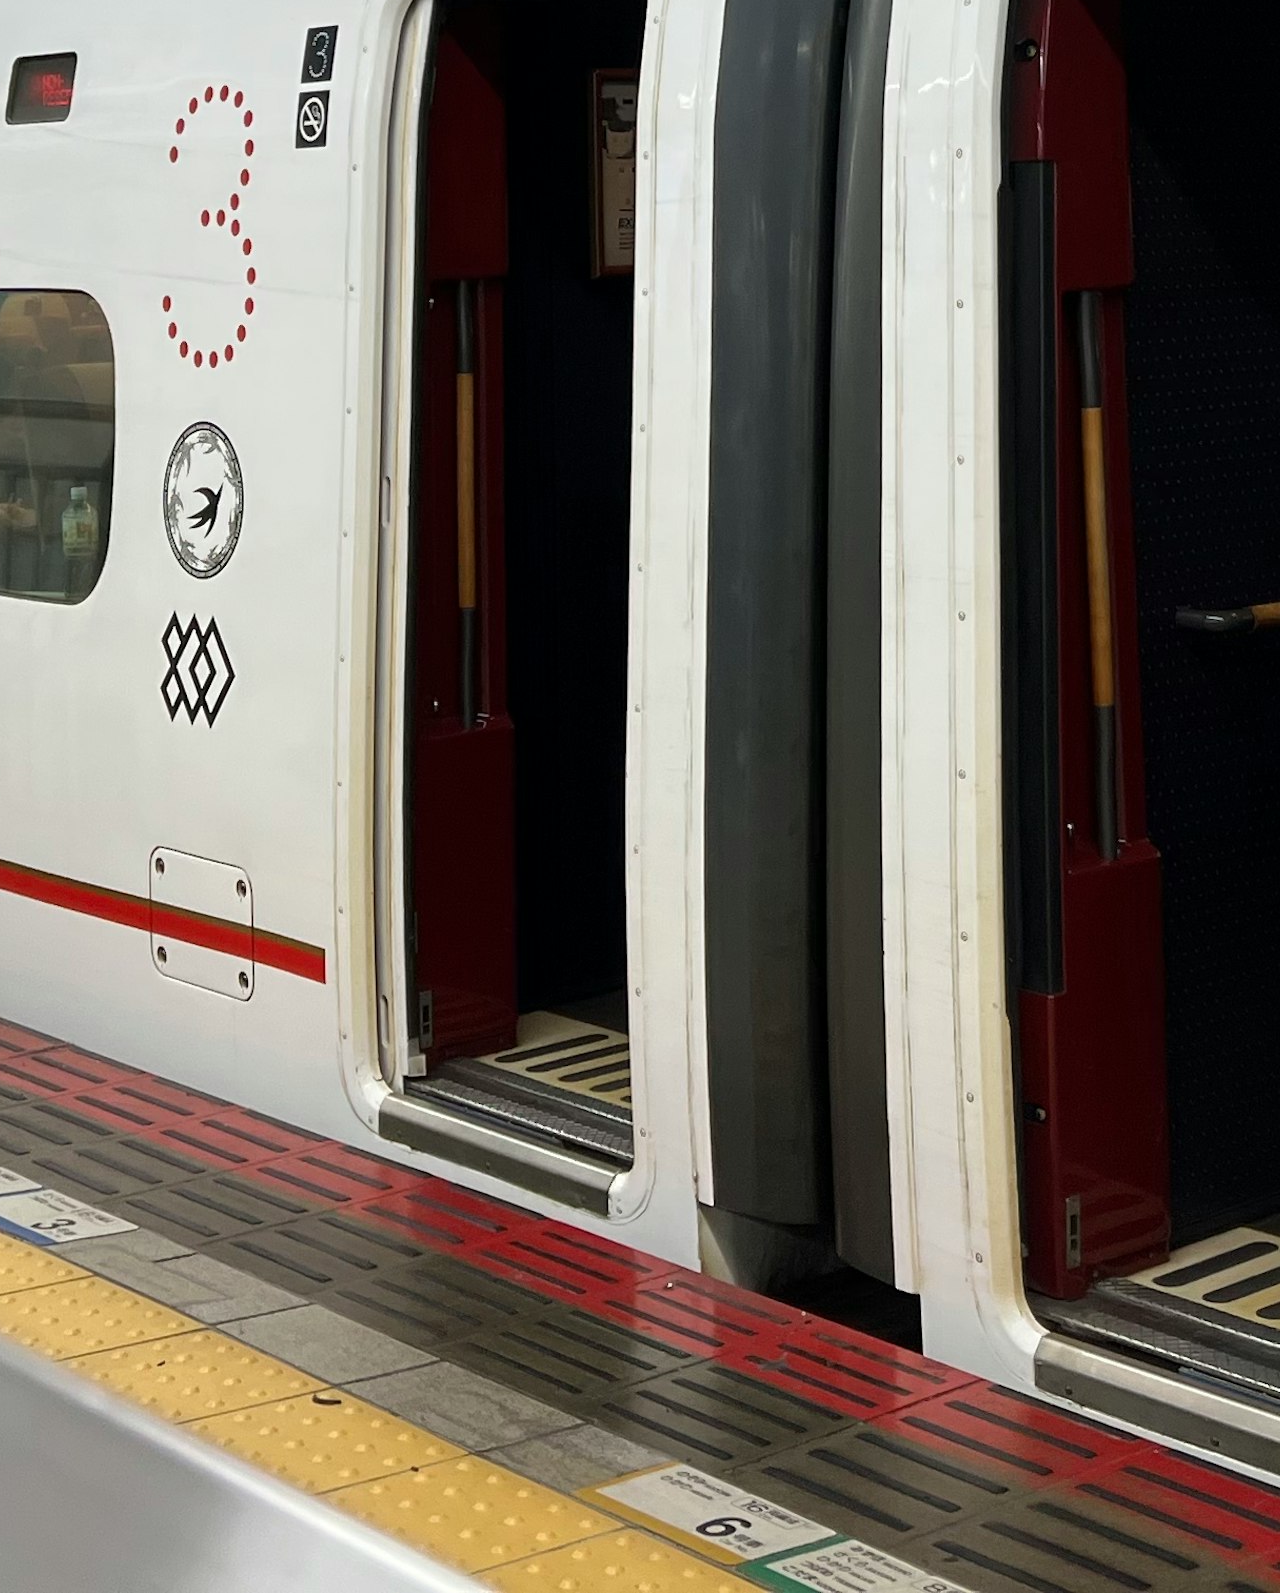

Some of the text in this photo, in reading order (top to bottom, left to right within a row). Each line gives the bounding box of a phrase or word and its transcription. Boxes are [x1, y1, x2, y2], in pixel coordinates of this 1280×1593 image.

[308, 31, 330, 78] 3
[162, 85, 256, 369] 3
[30, 1218, 77, 1230] 3
[695, 1517, 753, 1538] 6
